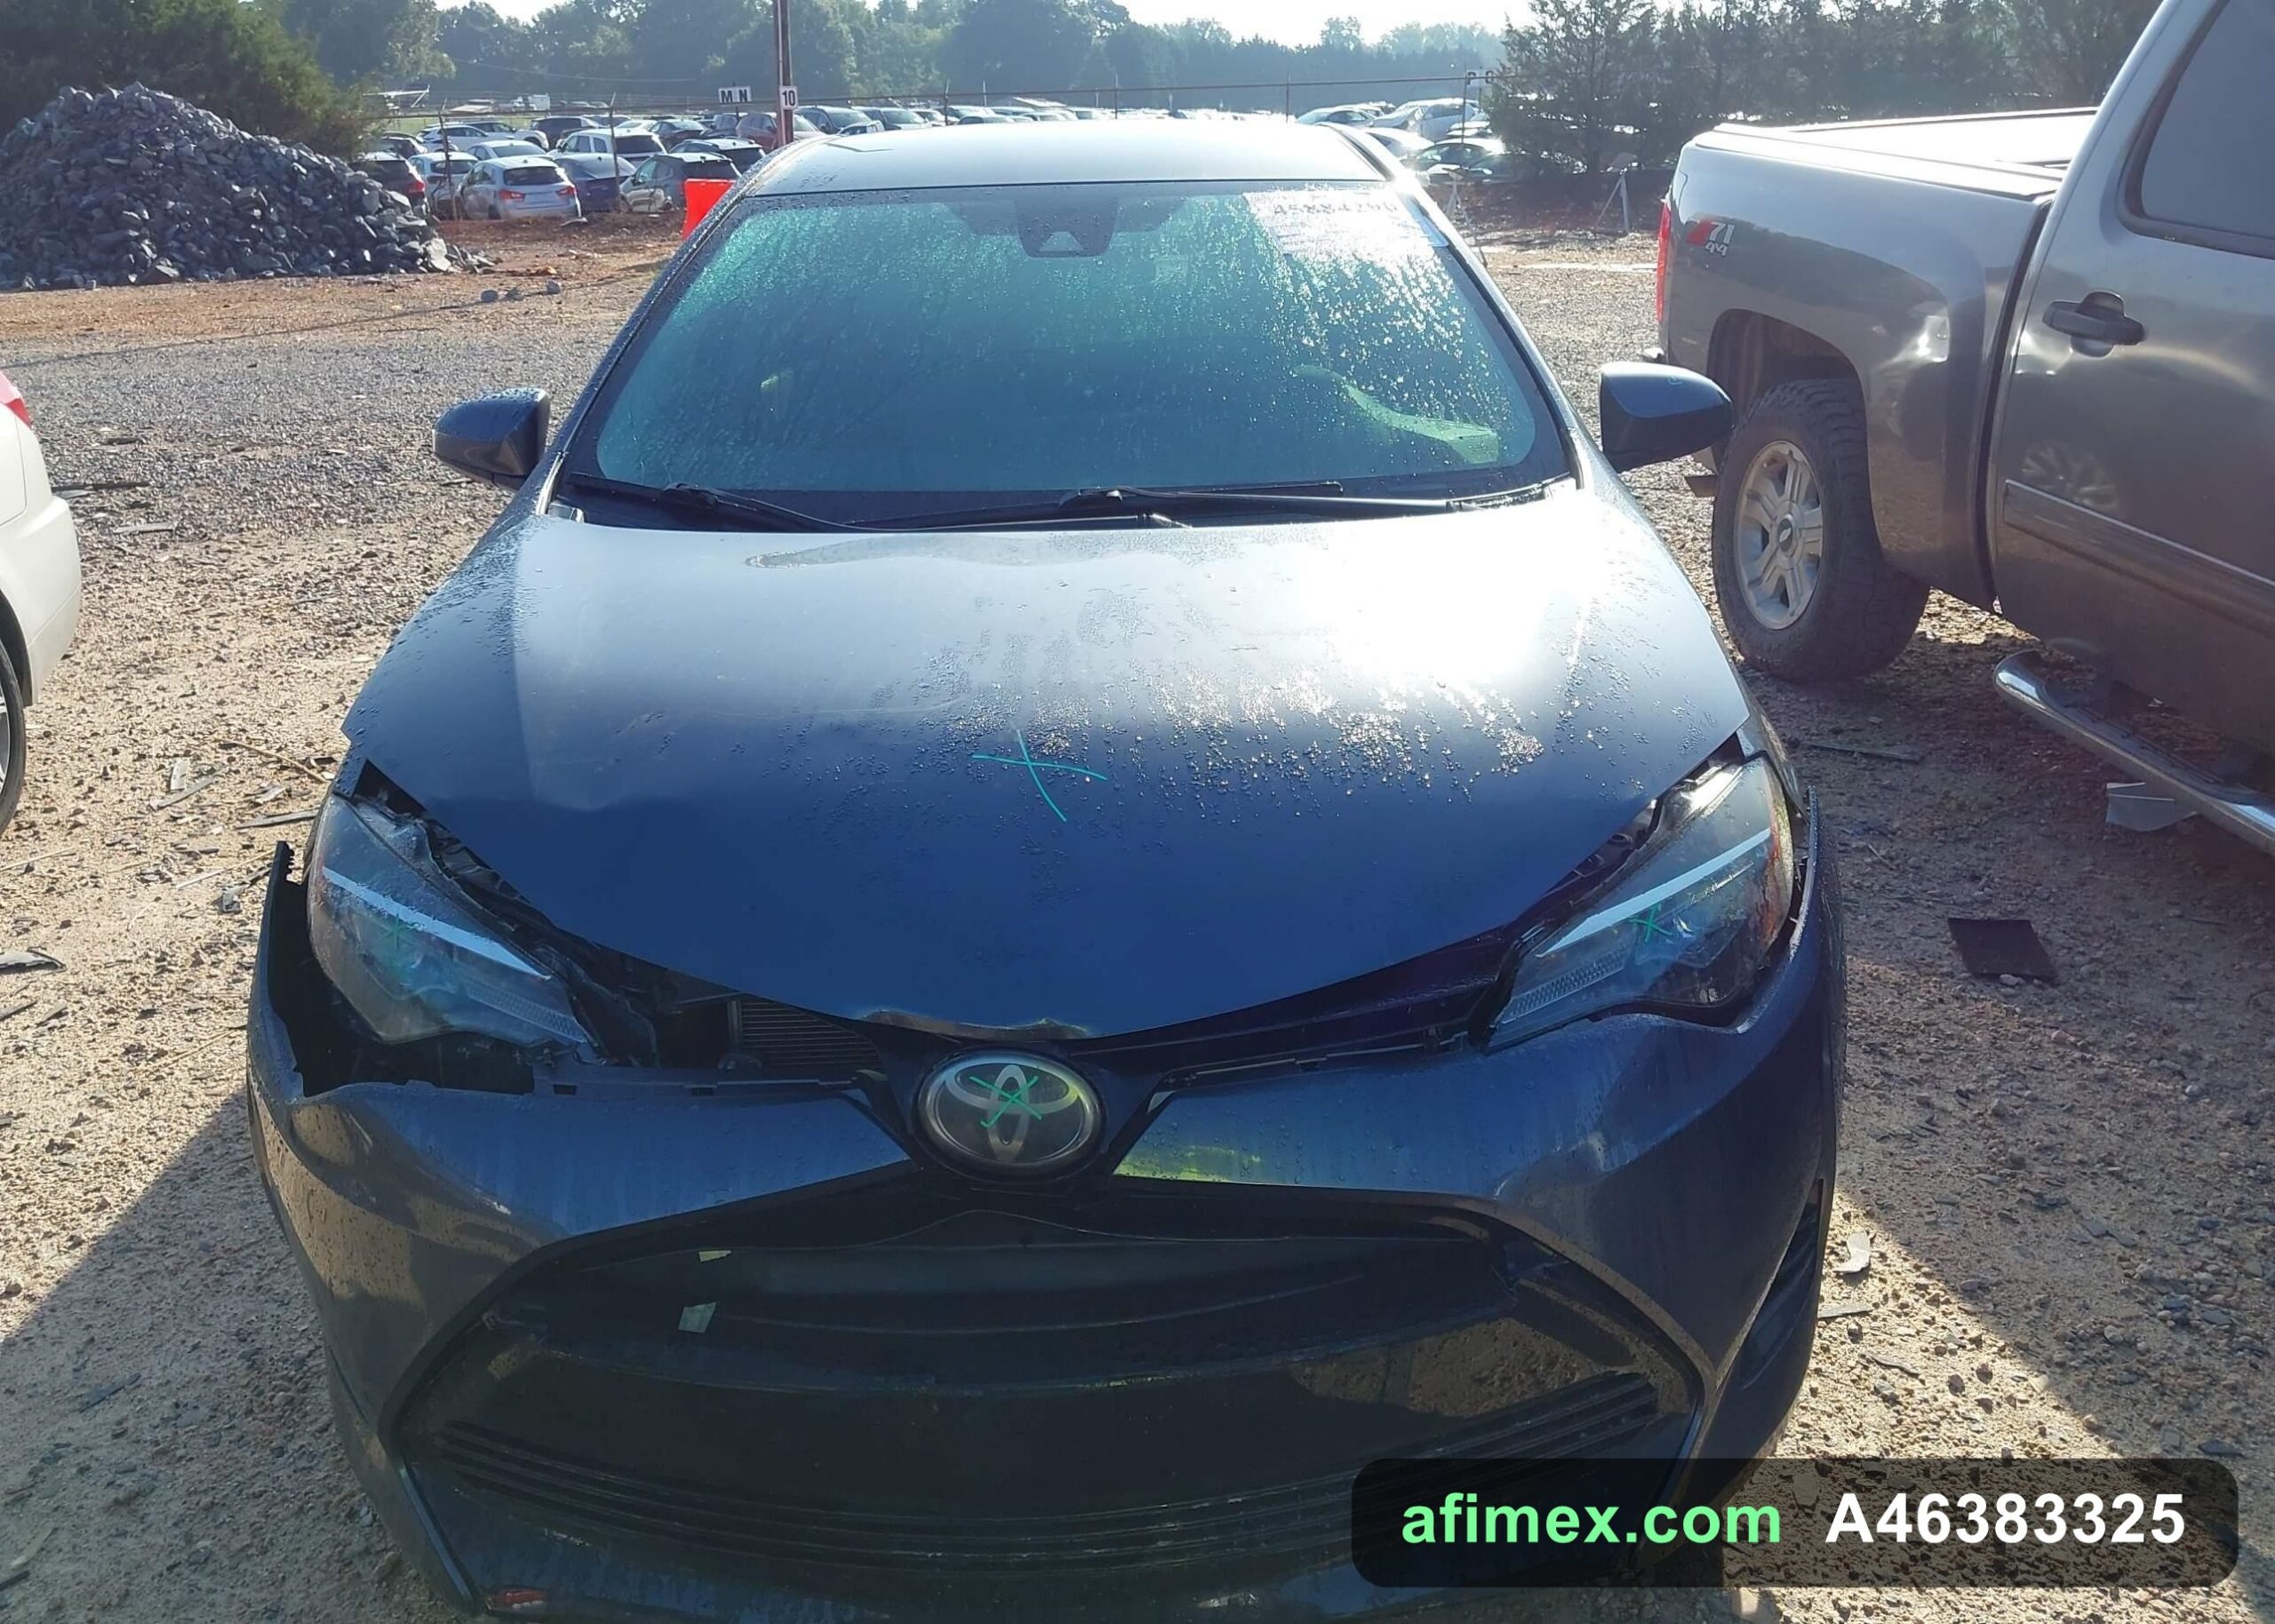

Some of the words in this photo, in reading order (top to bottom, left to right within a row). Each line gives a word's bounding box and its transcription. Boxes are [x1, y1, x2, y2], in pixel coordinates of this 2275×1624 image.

[721, 90, 733, 103] M
[738, 89, 747, 102] N
[782, 90, 796, 107] 10
